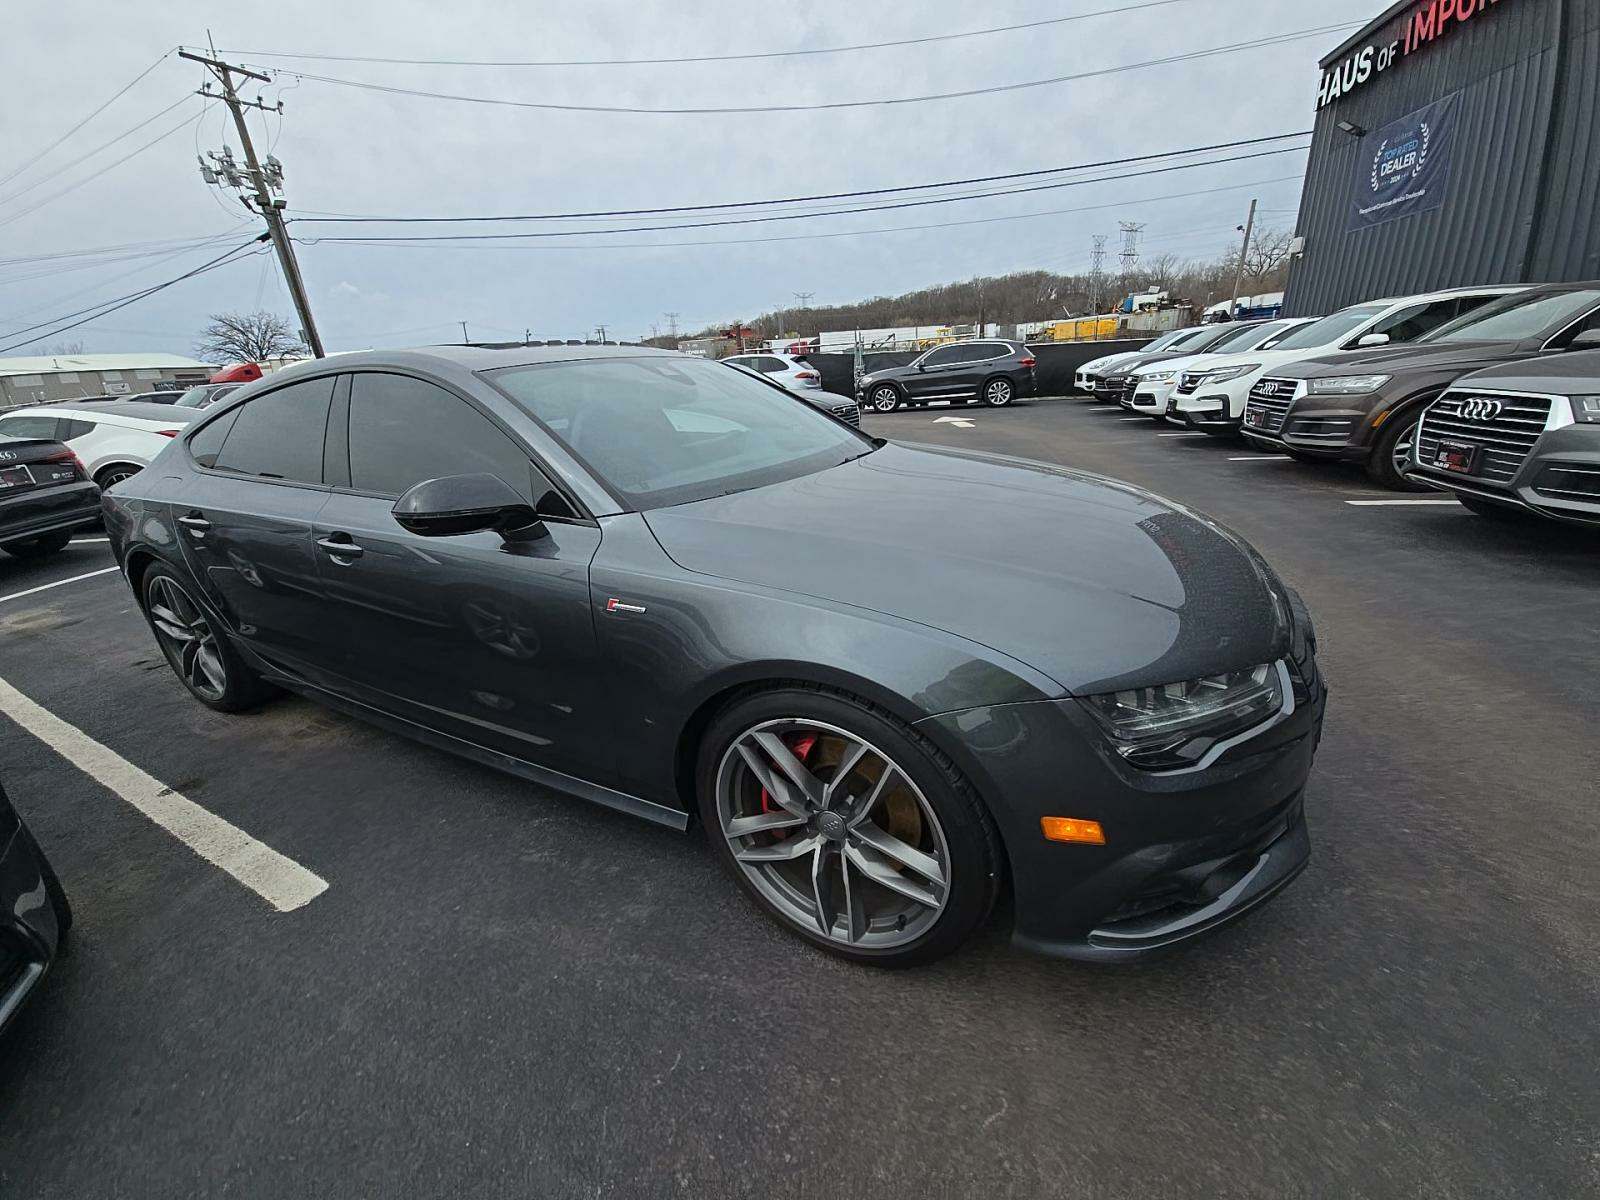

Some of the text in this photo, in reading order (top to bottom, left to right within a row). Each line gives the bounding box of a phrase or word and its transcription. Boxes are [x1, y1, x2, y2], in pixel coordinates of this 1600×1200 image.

[1315, 0, 1499, 110] HAUS OF IMPO
[1384, 139, 1419, 161] TOP RATED
[1380, 152, 1417, 176] DEALER
